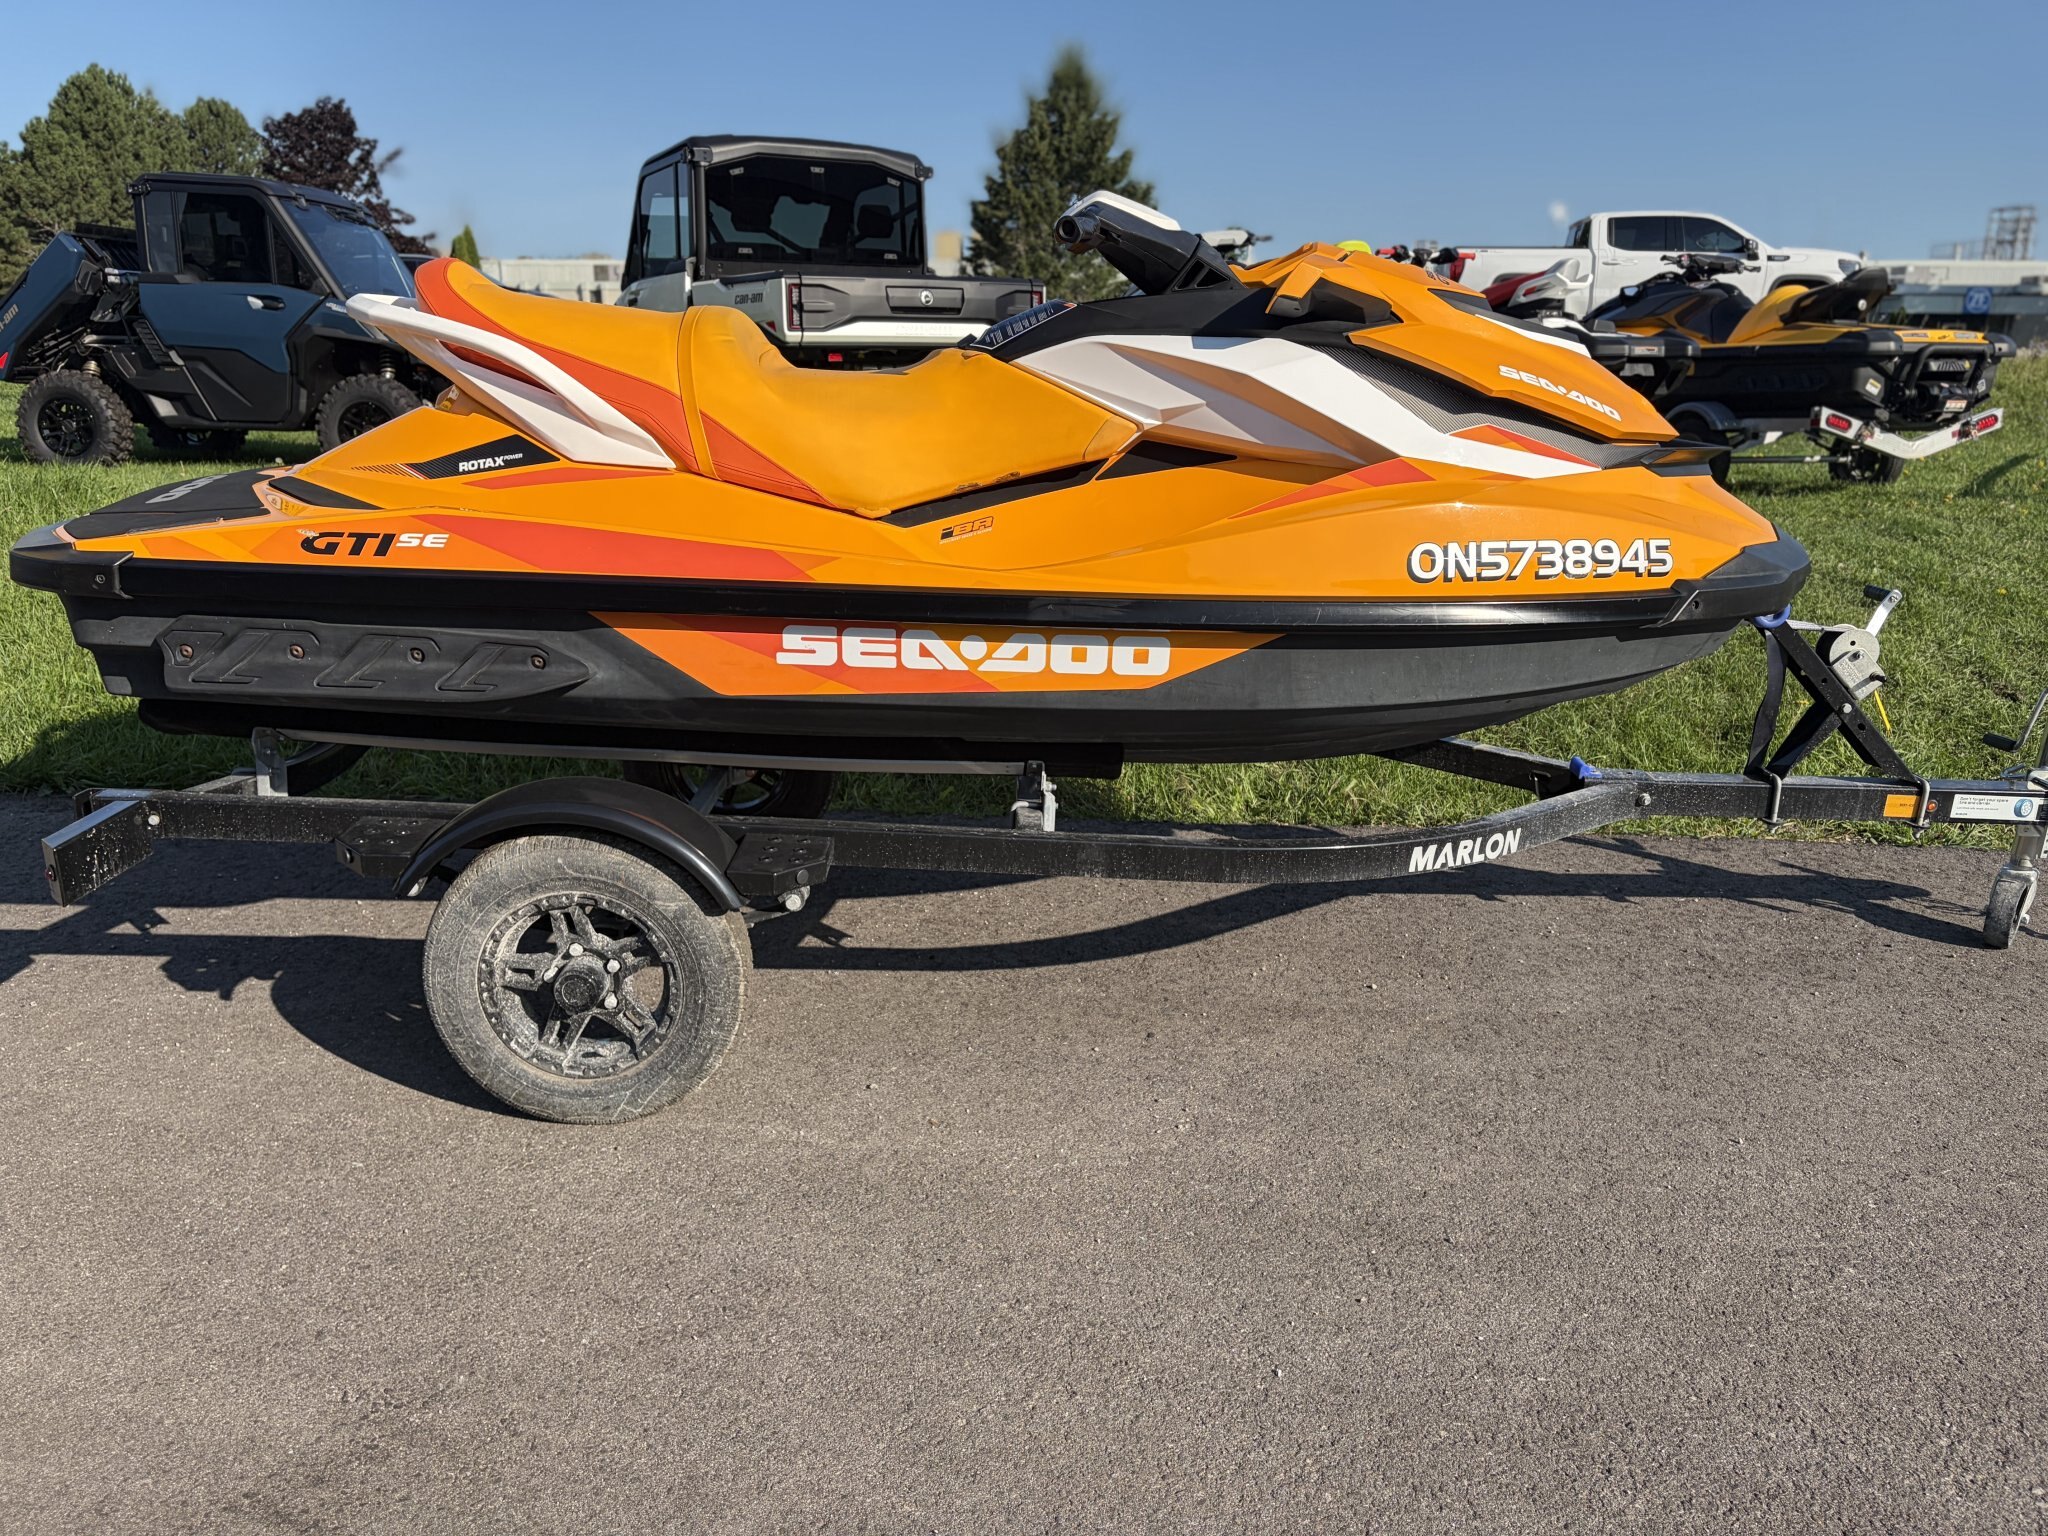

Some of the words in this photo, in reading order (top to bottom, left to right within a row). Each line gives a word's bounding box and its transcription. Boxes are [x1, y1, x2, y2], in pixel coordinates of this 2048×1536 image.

[734, 292, 764, 305] can-am
[458, 456, 505, 472] ROTAX
[503, 453, 523, 461] POWER
[300, 531, 397, 557] GTI
[396, 533, 449, 548] SE
[1407, 538, 1674, 583] ON5738945
[1408, 828, 1521, 873] MARLON
